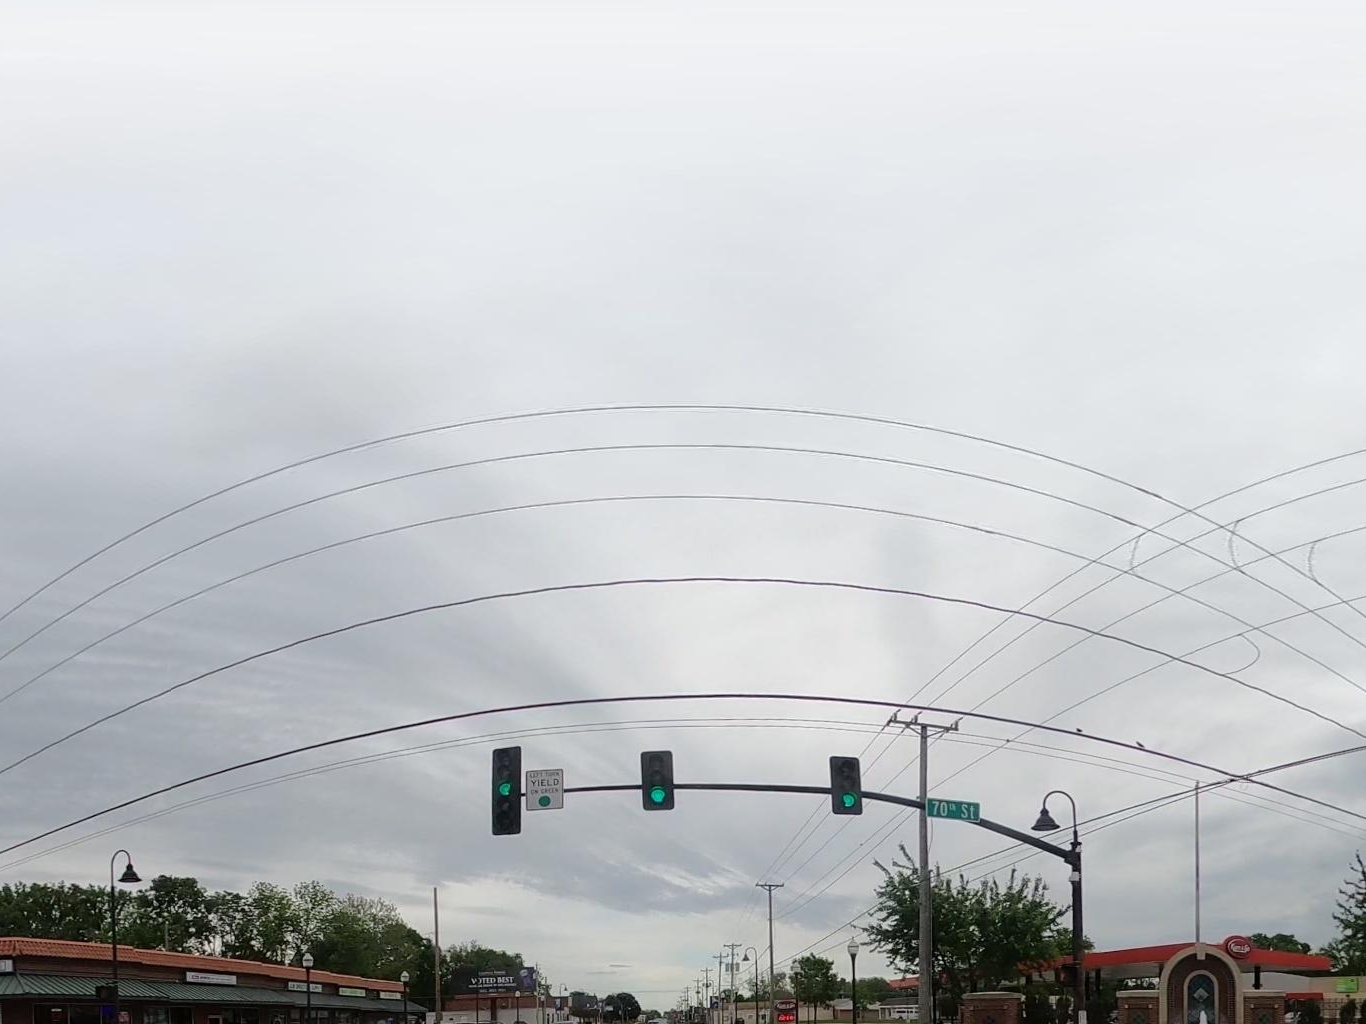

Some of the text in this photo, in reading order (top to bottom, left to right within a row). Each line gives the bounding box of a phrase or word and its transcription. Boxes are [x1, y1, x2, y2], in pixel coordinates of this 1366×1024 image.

[531, 778, 560, 787] YIELD
[932, 801, 976, 819] 70th St
